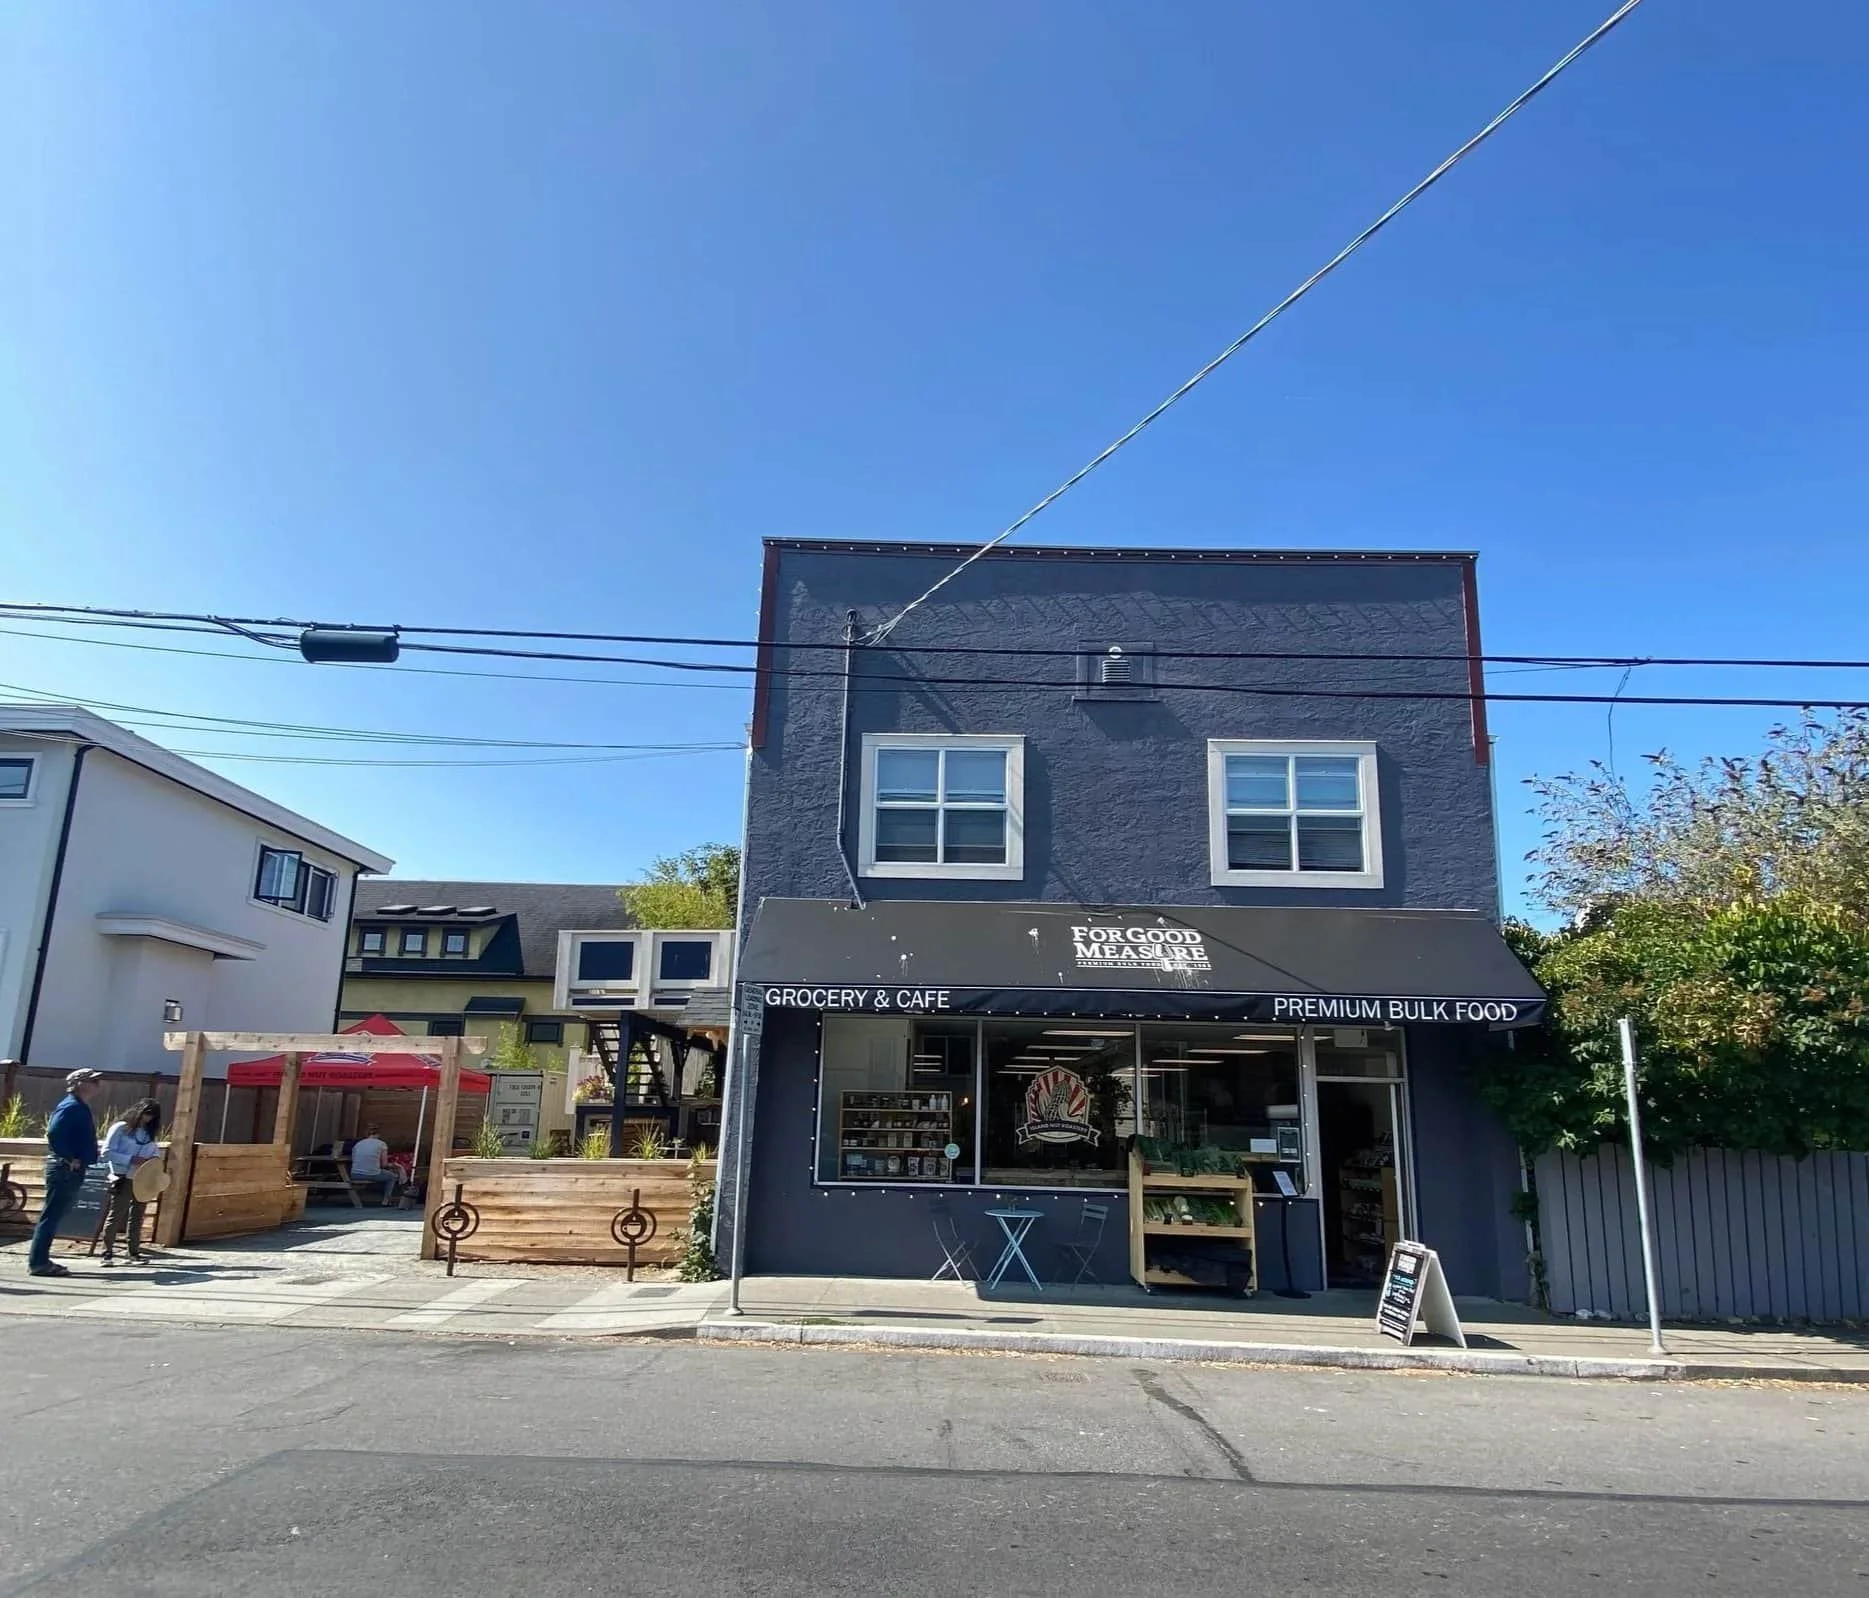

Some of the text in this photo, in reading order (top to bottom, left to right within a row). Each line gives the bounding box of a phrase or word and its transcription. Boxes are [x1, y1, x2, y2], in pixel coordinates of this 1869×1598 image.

[1073, 942, 1209, 961] MEASURE
[765, 988, 869, 1008] GROCERY
[874, 989, 890, 1008] &
[896, 990, 951, 1009] CAFE
[1273, 997, 1518, 1022] PREMIUM BULK FOOD
